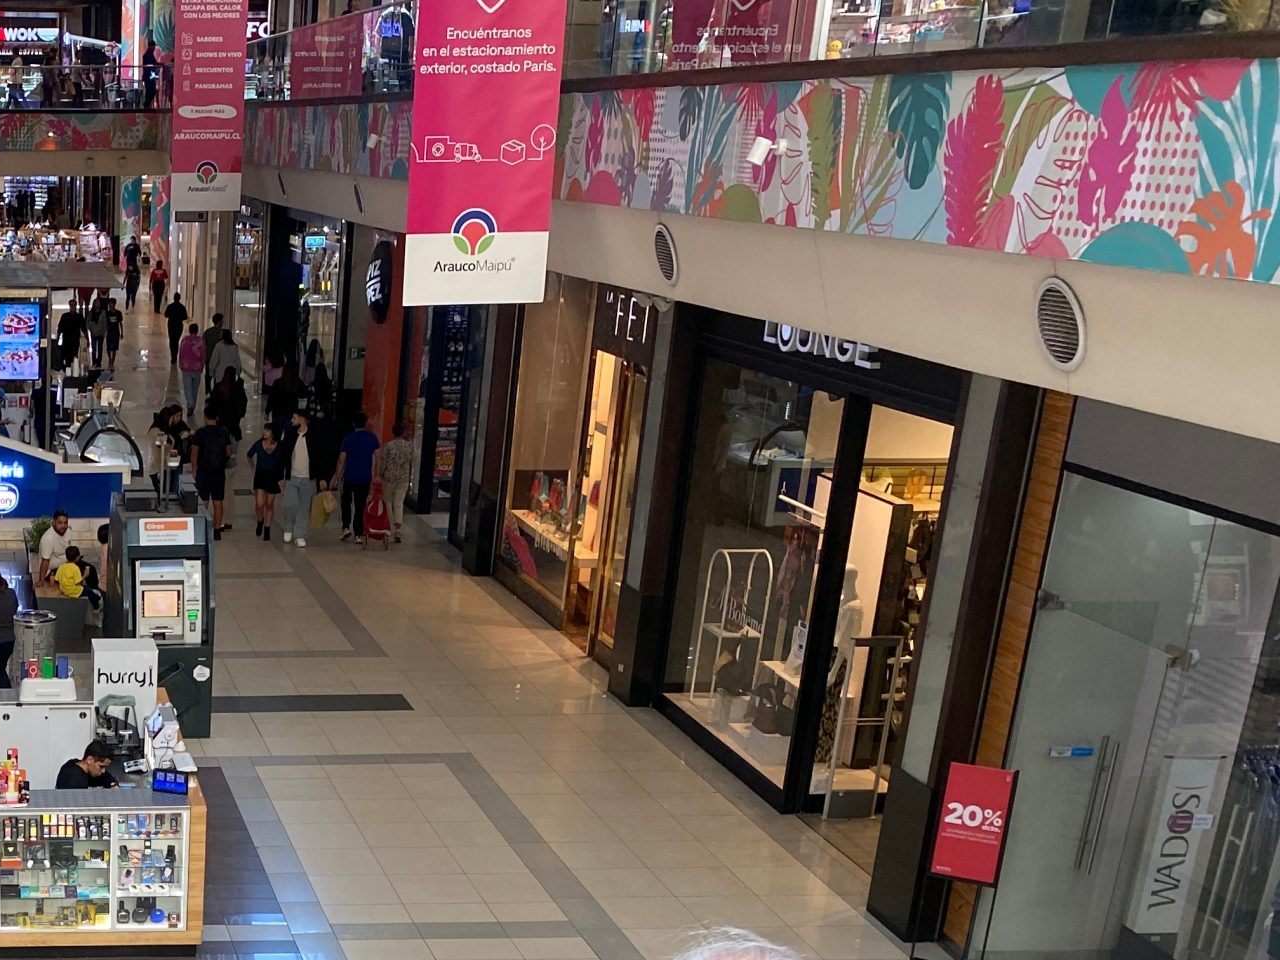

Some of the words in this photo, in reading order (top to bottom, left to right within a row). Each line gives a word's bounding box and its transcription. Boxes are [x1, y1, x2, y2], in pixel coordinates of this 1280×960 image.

[446, 26, 532, 40] Encuéntranos
[422, 48, 438, 58] en
[440, 44, 450, 57] el
[452, 42, 556, 57] estacionamiento
[420, 62, 469, 76] exterior,
[470, 60, 521, 74] costado
[523, 60, 557, 73] Paris.
[762, 320, 881, 370] LOUNGE
[944, 802, 1002, 827] 20%
